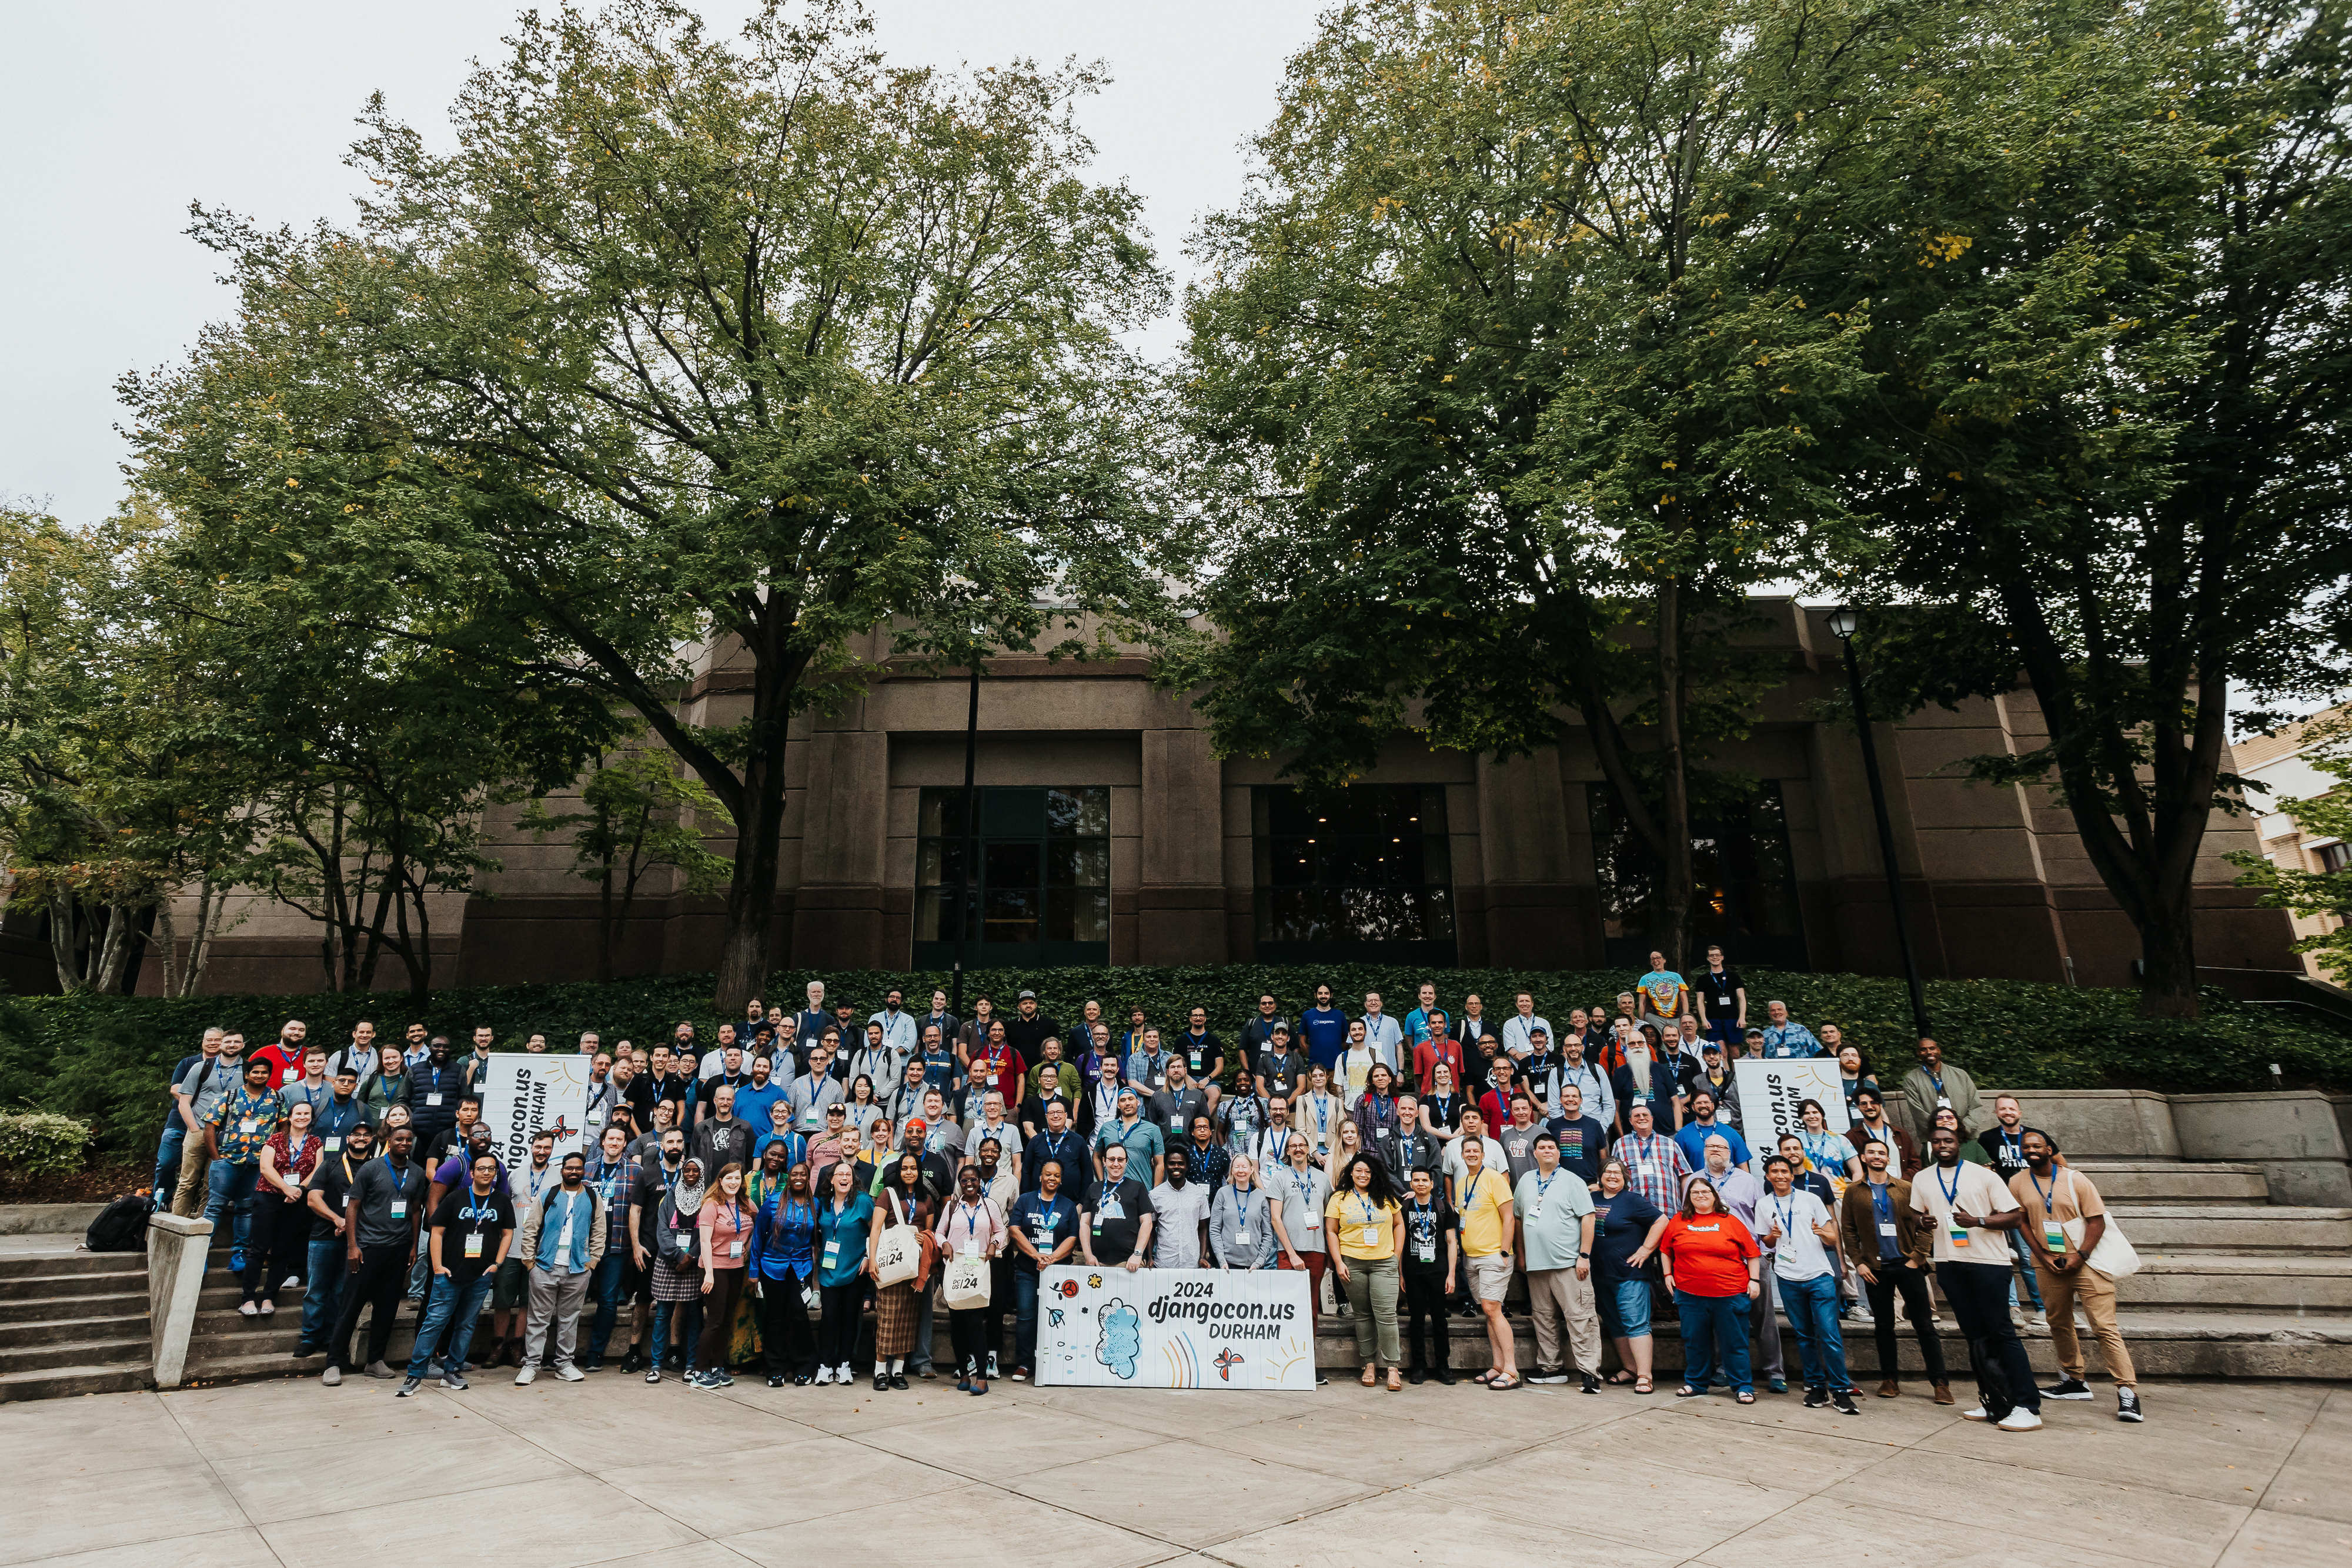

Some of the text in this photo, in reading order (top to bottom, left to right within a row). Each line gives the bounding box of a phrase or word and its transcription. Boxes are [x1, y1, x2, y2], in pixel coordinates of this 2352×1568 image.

[1027, 1212, 1054, 1221] SUPPT
[1031, 1218, 1052, 1226] BLAK
[889, 1252, 903, 1265] 24
[963, 1278, 978, 1289] 24
[1173, 1282, 1214, 1298] 2024
[1148, 1295, 1295, 1324] djangocon.us
[1209, 1323, 1281, 1340] DURHAM
